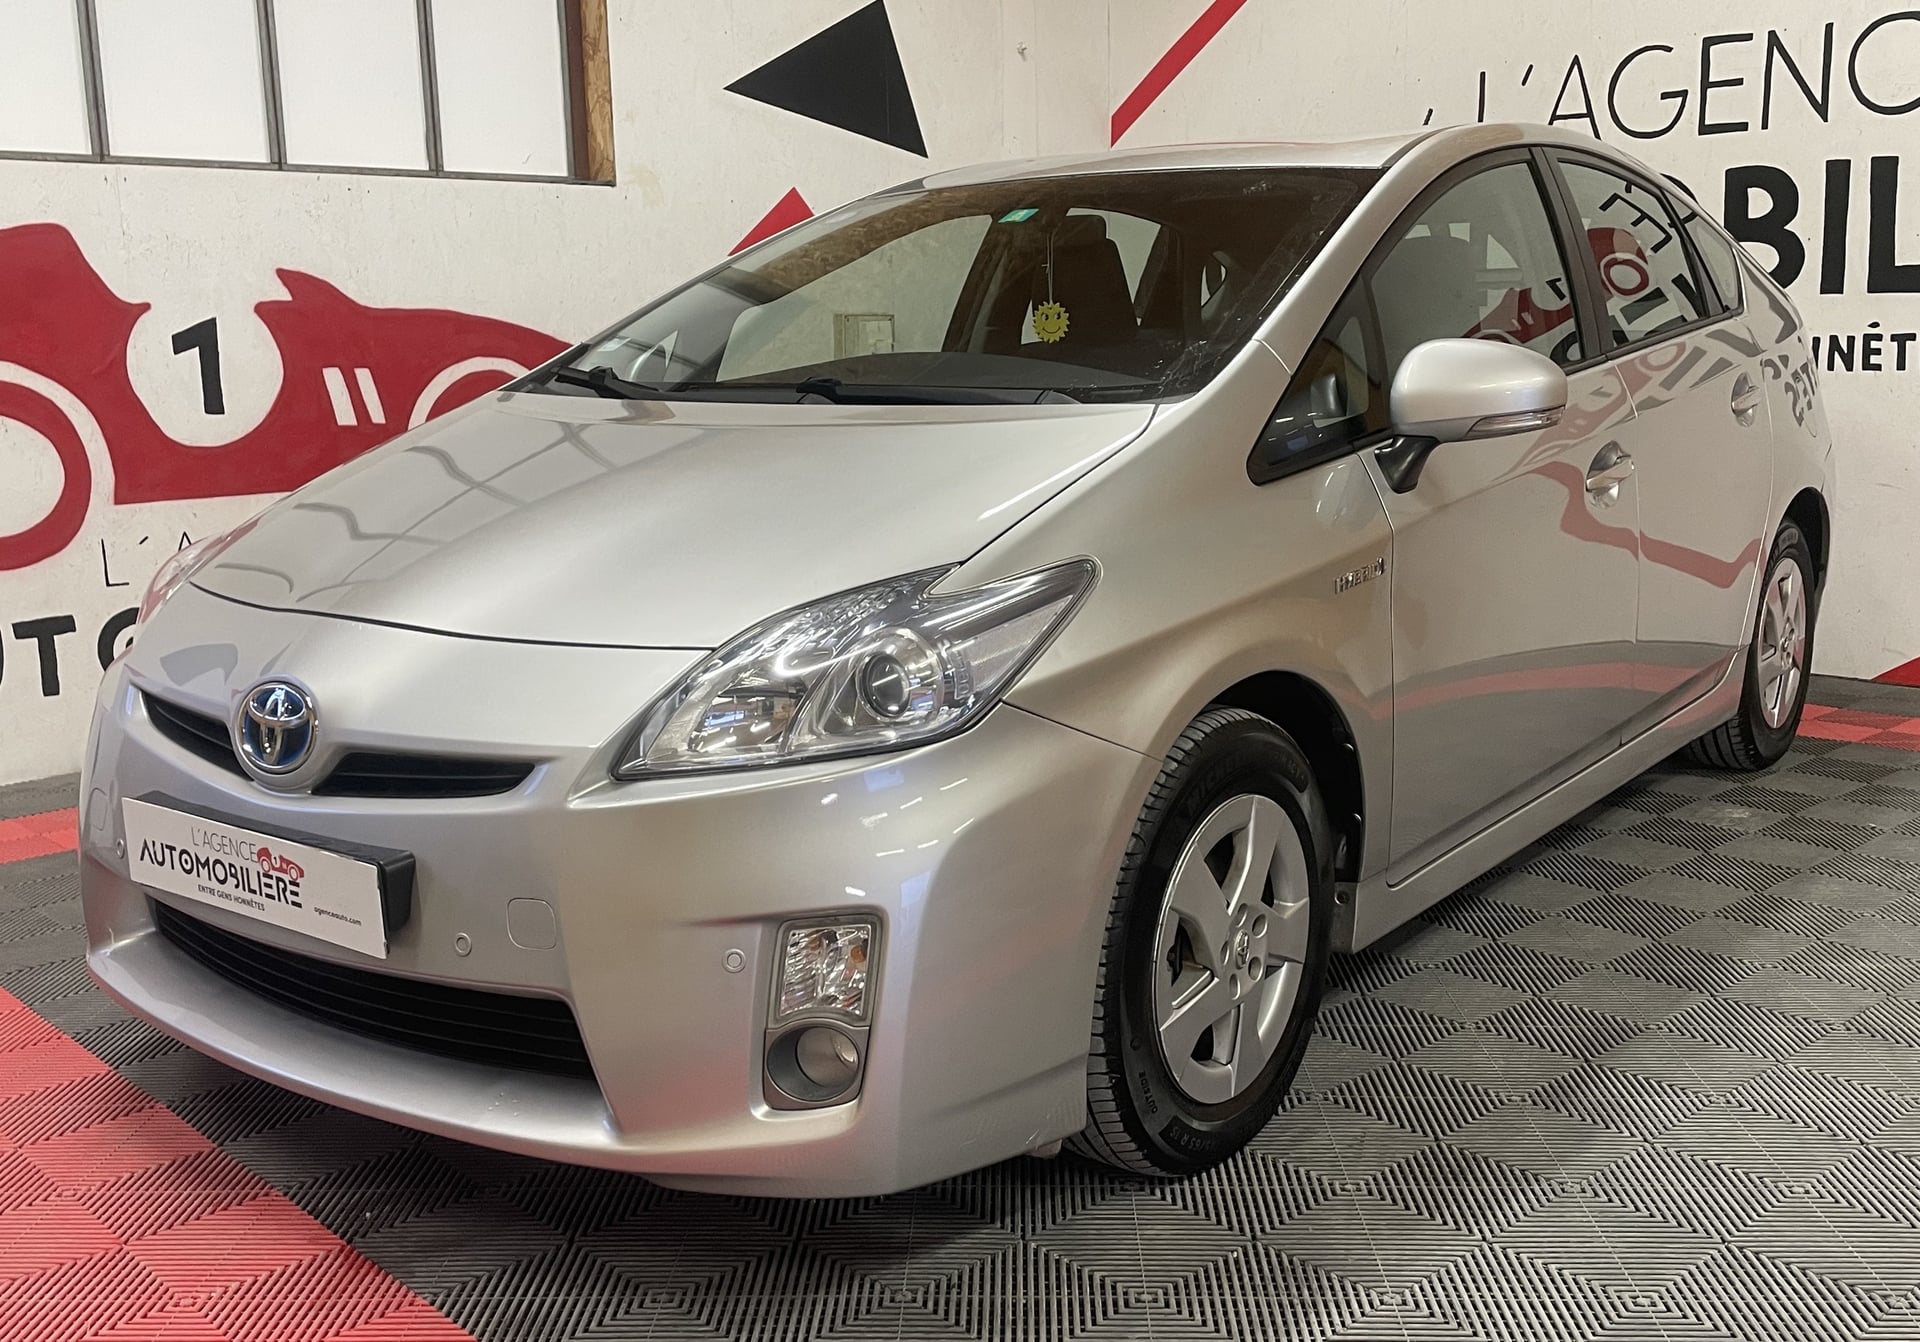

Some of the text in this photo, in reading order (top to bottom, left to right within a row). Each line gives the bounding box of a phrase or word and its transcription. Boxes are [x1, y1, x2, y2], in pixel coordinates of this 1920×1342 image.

[1660, 156, 1920, 294] BIL
[171, 317, 226, 416] 1
[1811, 322, 1917, 373] NÉT
[1334, 557, 1384, 594] HYBRID
[191, 826, 258, 865] L'AGENCE
[198, 884, 217, 897] ENTRE
[216, 889, 233, 902] GENS
